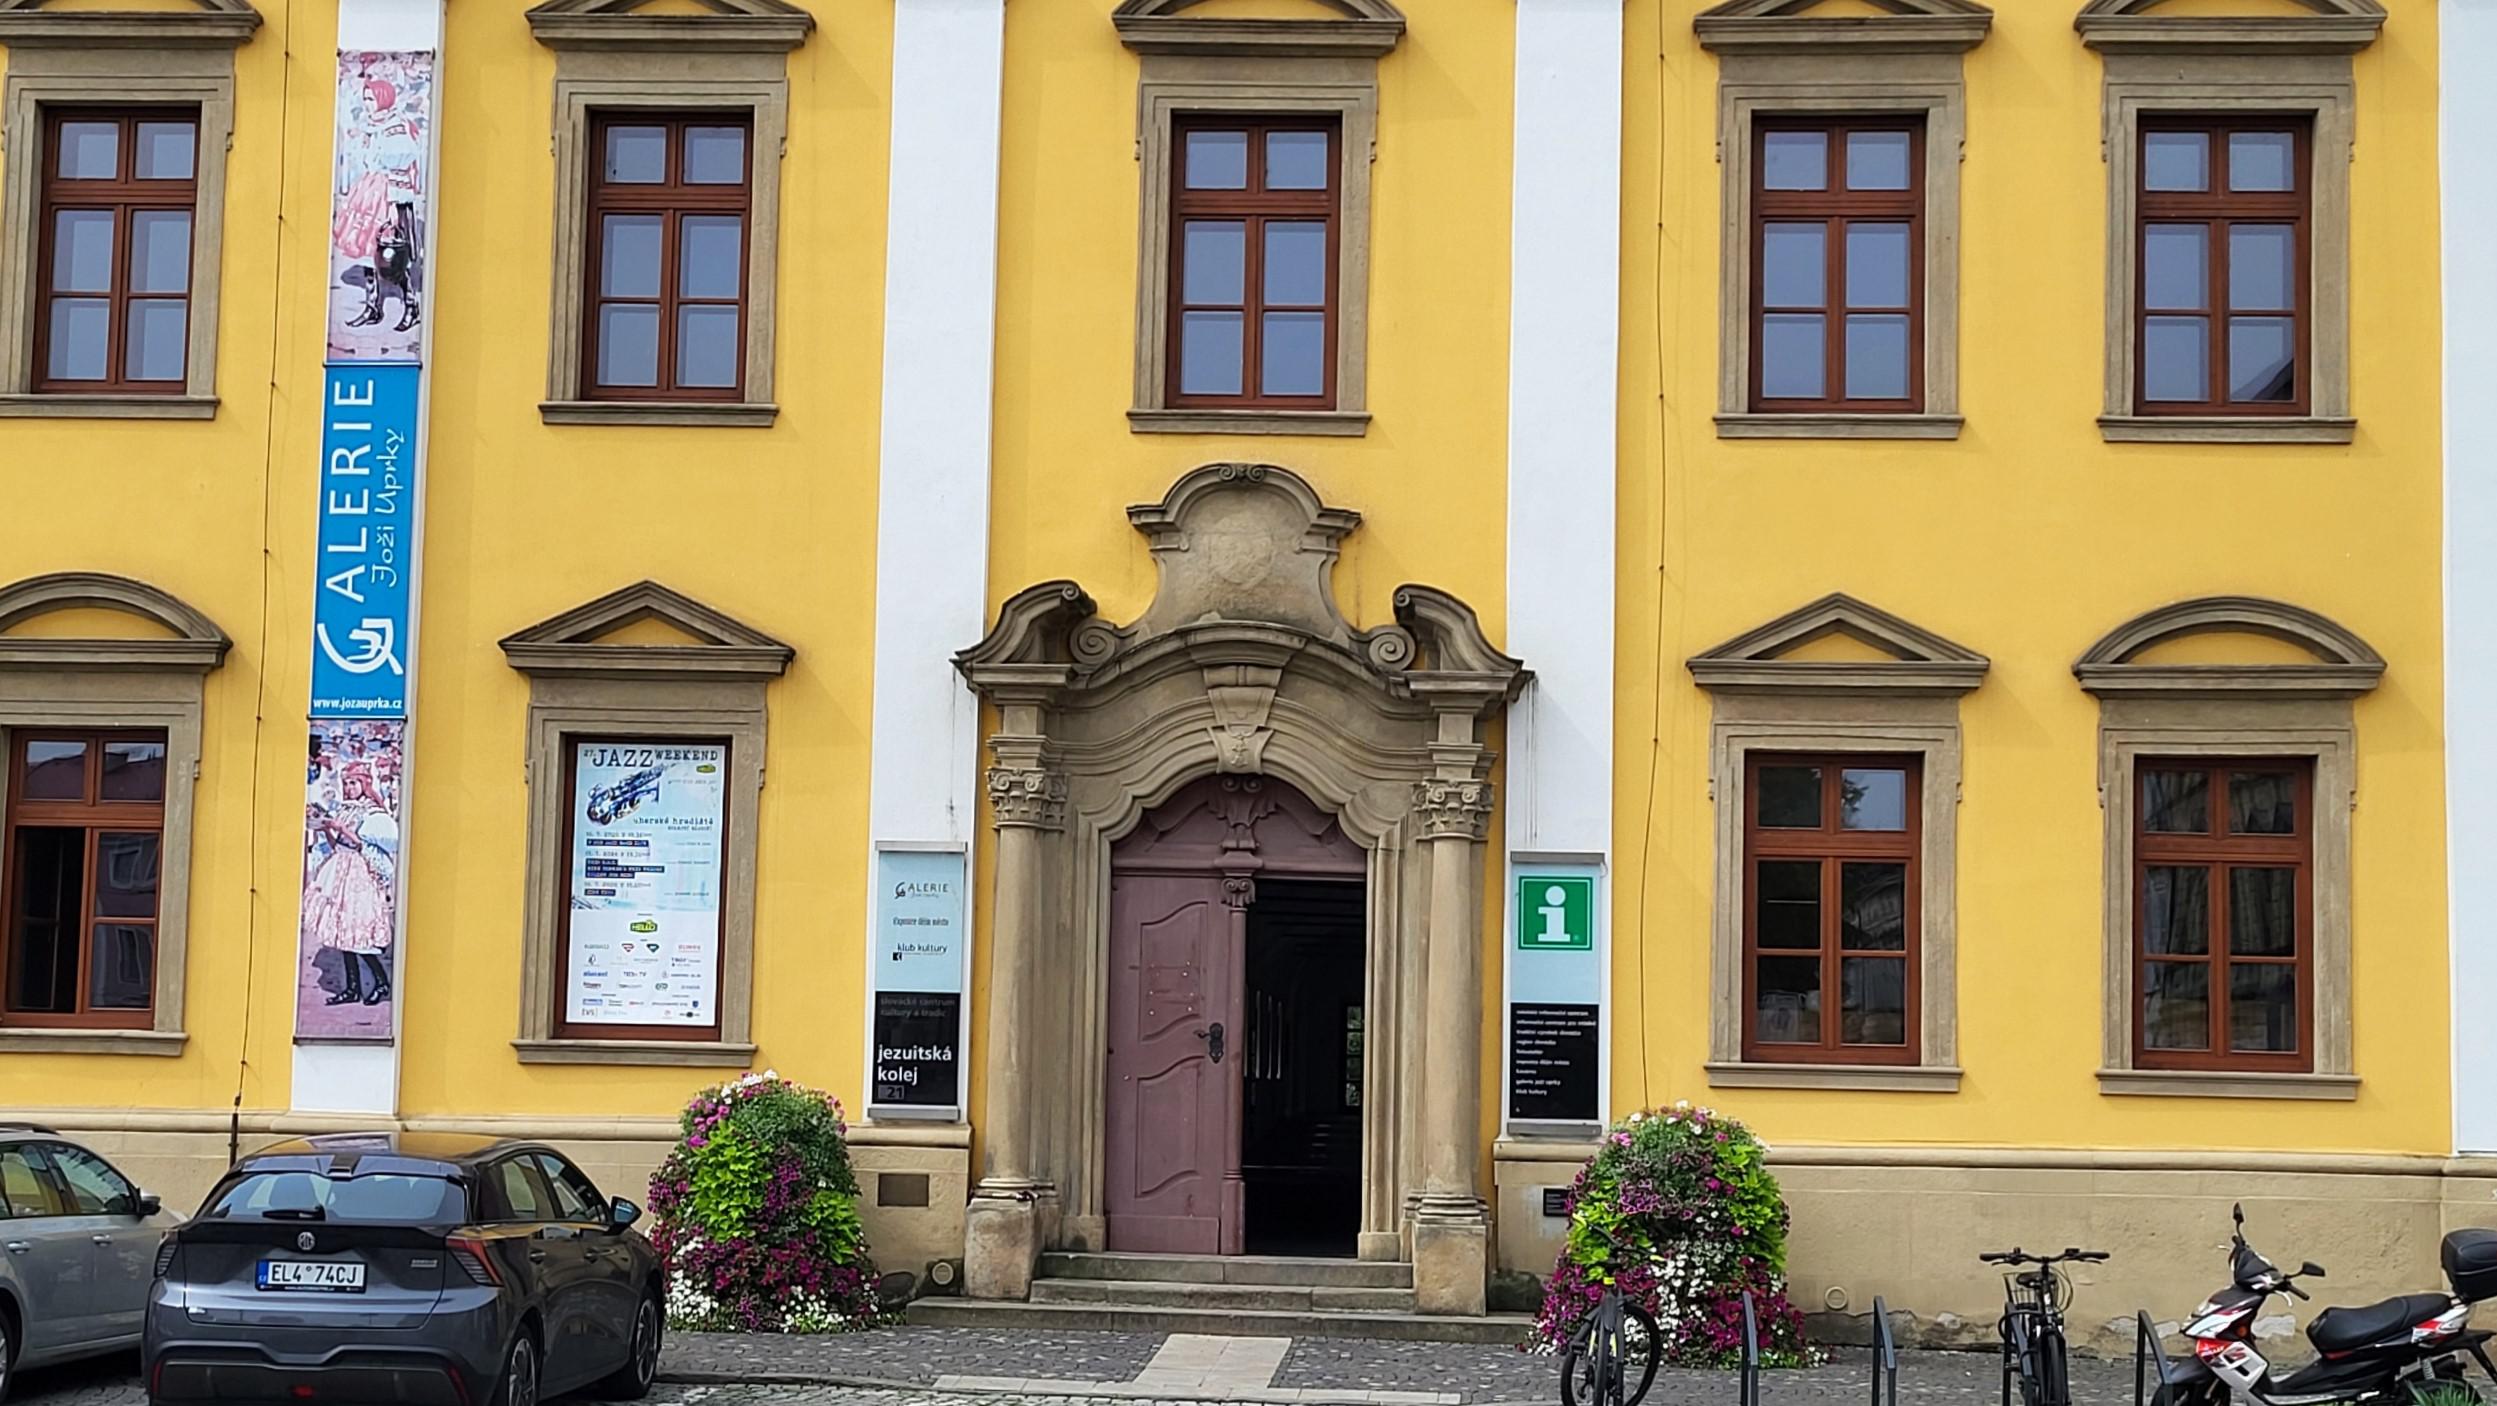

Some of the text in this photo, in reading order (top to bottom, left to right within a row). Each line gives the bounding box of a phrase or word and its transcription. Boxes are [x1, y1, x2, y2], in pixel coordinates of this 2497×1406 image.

[371, 428, 405, 588] Joži Uprky
[313, 696, 402, 711] www.jozauprka.cz
[592, 749, 654, 767] JAZZ
[655, 750, 718, 761] WEEKEND
[897, 942, 948, 953] klub kultury
[877, 1044, 952, 1064] jezuitská
[878, 1066, 918, 1086] kolej
[887, 1087, 904, 1098] 21
[271, 1264, 358, 1284] EL4 74CJ
